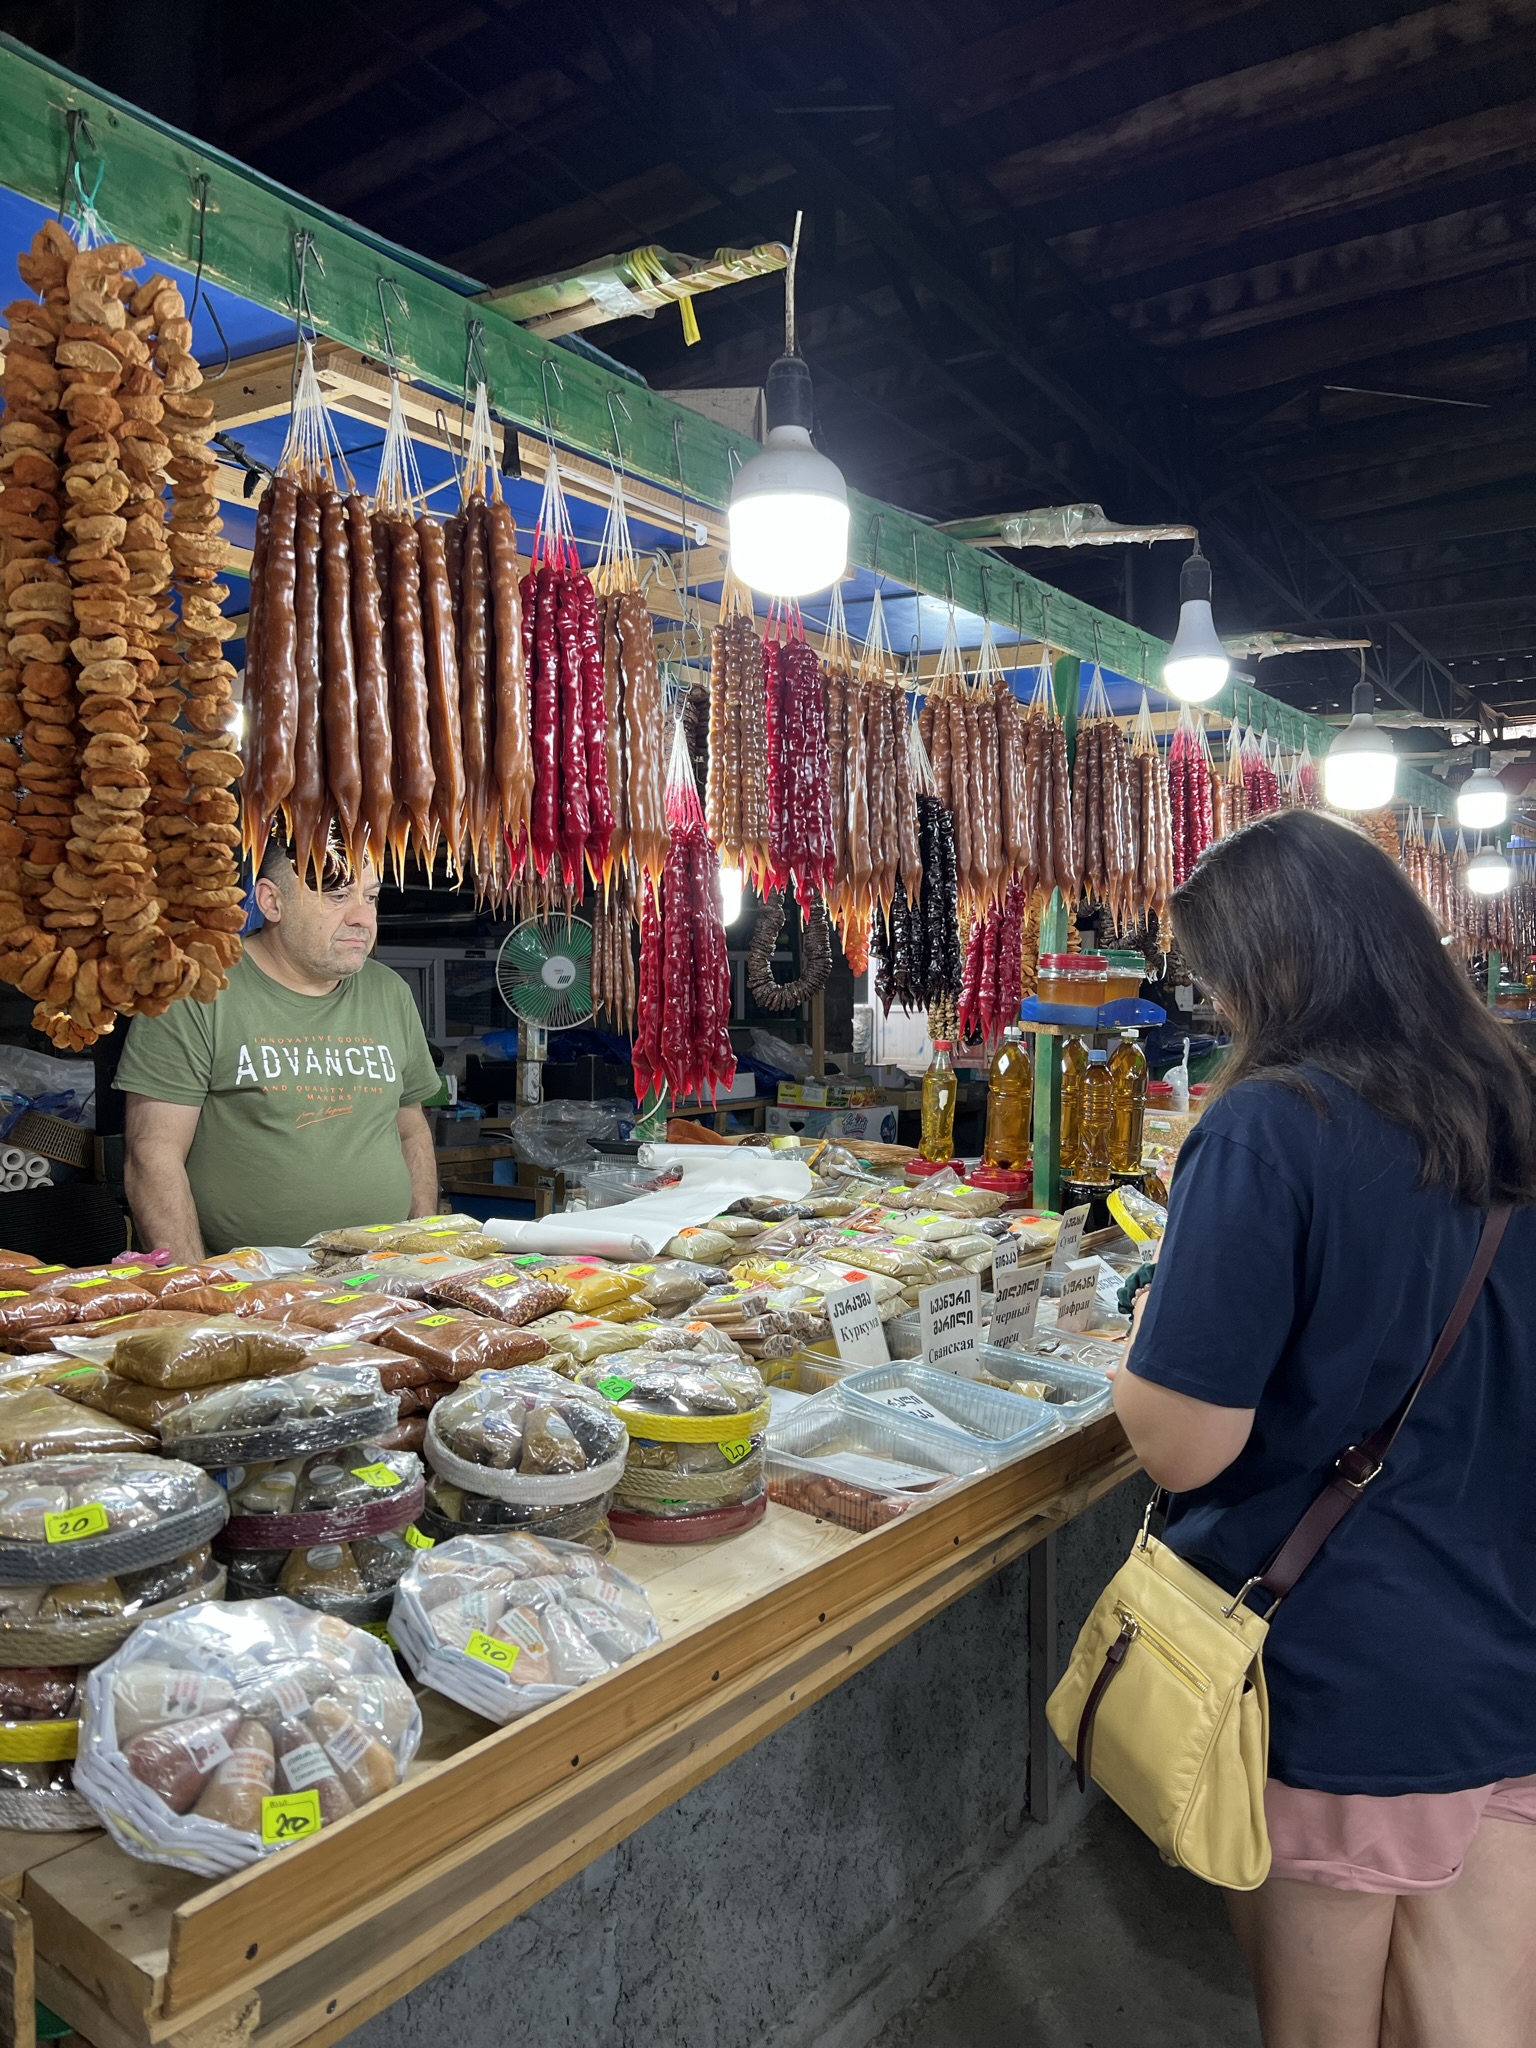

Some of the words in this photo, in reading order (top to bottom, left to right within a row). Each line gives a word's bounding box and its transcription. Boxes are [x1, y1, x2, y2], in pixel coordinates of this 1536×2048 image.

[254, 1034, 333, 1044] INNOVATIVE
[337, 1036, 375, 1044] GOODS
[235, 1044, 396, 1086] ADVANCED
[262, 1084, 288, 1093] AND
[296, 1085, 345, 1094] QUALITY
[353, 1085, 384, 1094] ITEMS
[306, 1093, 353, 1103] MAKERS
[996, 1278, 1040, 1303] პილპილი
[833, 1291, 872, 1319] კურკუმა
[930, 1289, 971, 1315] სვანური
[995, 1301, 1031, 1325] черный
[1059, 1299, 1091, 1319] Шафран
[840, 1317, 880, 1343] Куркума
[933, 1310, 974, 1336] მარილი
[928, 1338, 974, 1364] Сванская
[604, 1381, 624, 1394] 20
[726, 1443, 746, 1460] 20
[59, 1517, 89, 1535] 20
[480, 1642, 508, 1661] 20
